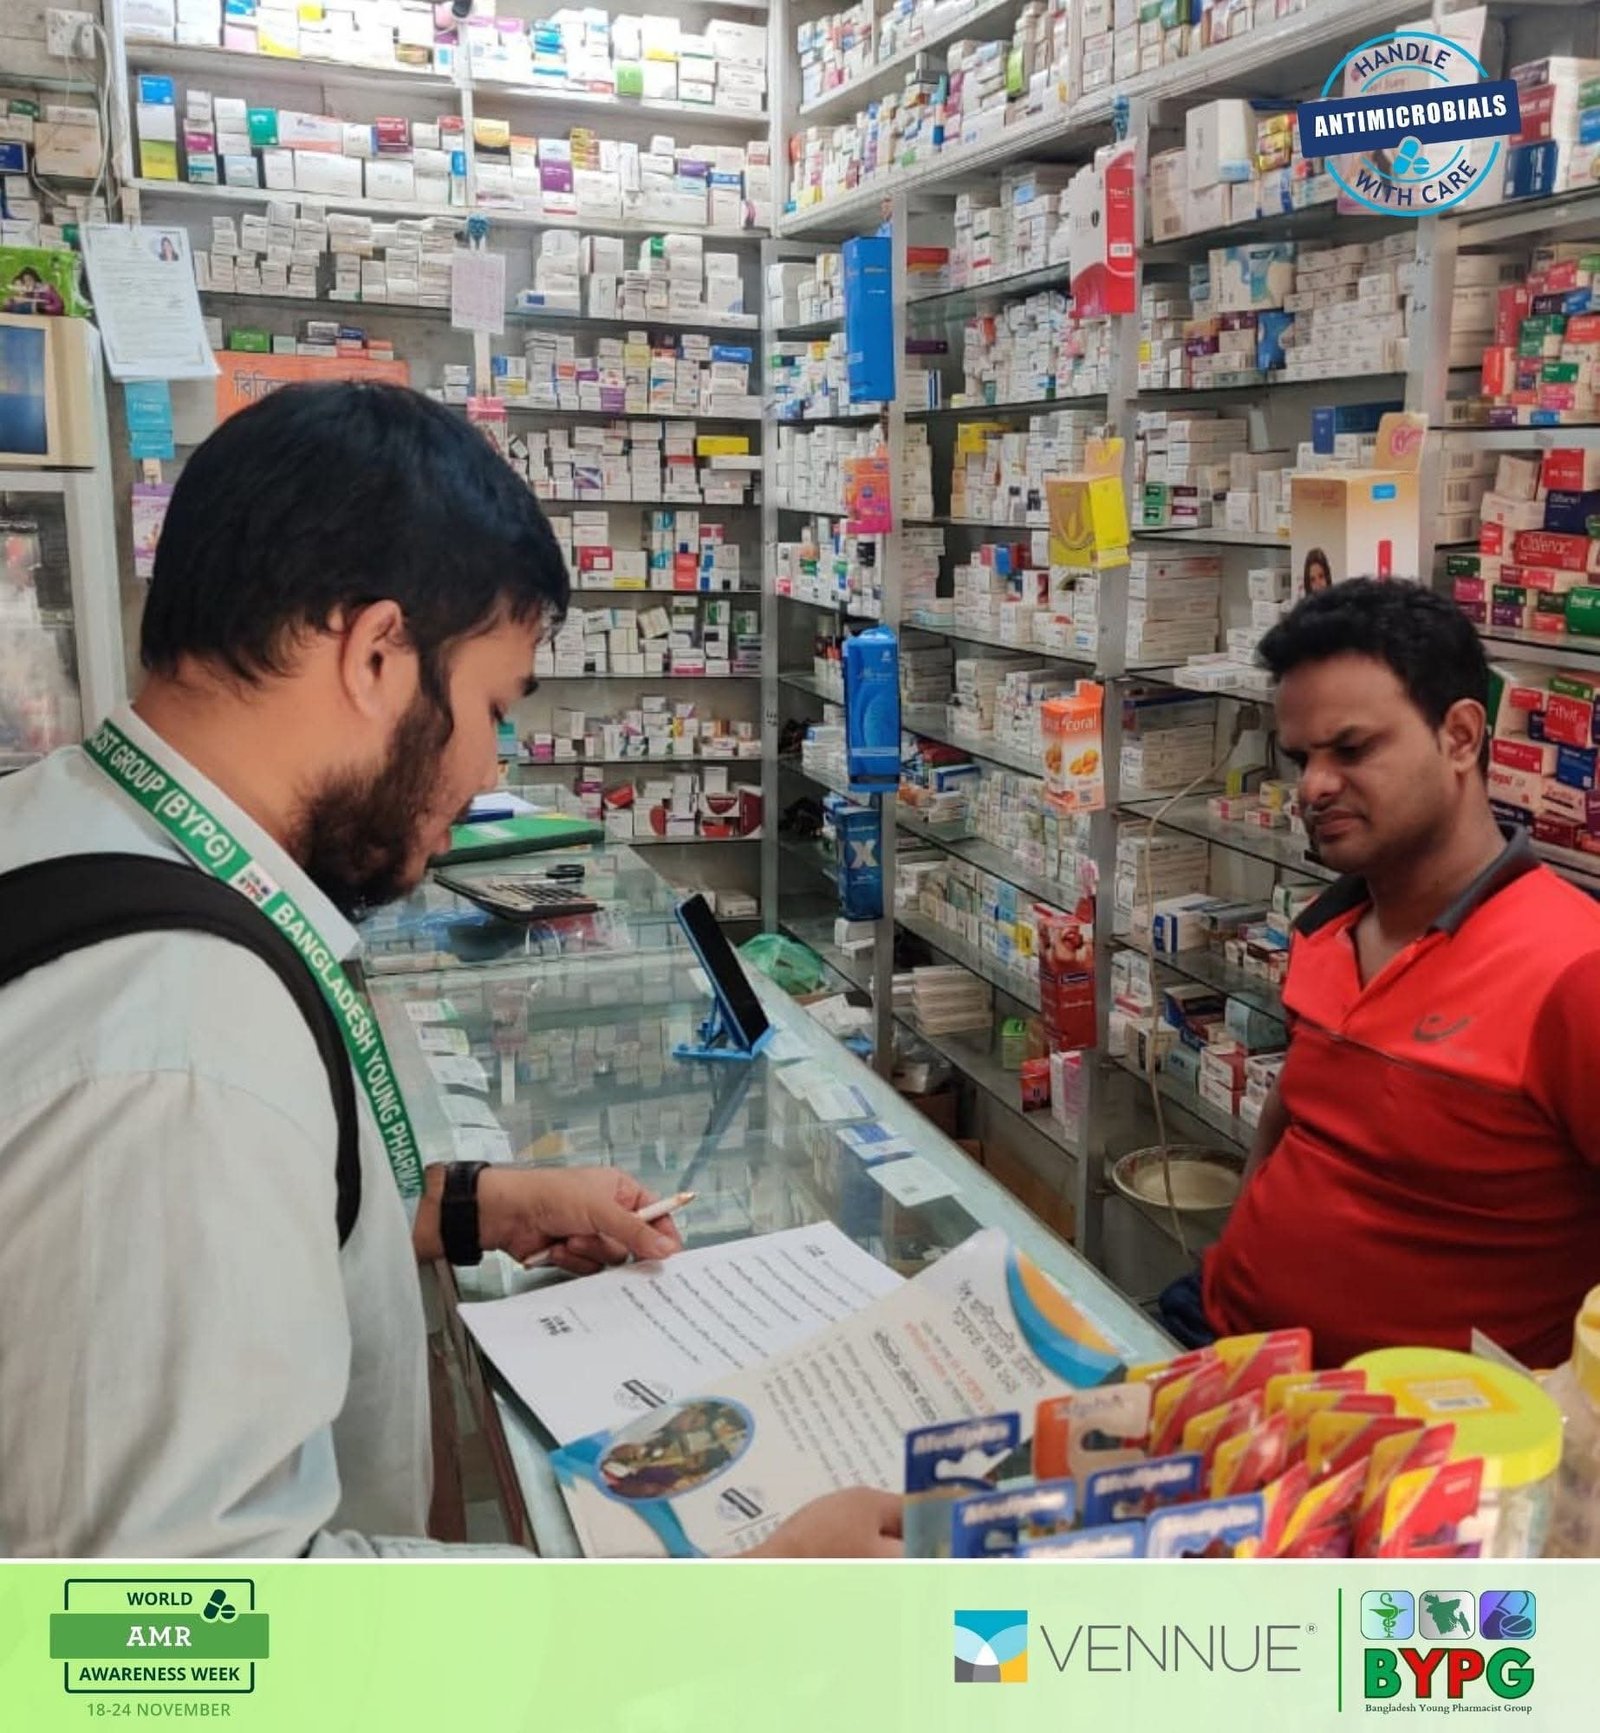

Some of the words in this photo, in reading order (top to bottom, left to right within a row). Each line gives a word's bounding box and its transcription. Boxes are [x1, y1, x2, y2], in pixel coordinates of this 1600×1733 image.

[110, 745, 167, 794] GROUP
[153, 788, 237, 868] (BYPG)
[273, 902, 378, 1055] BANGLADESH
[363, 1049, 402, 1125] YOUNG
